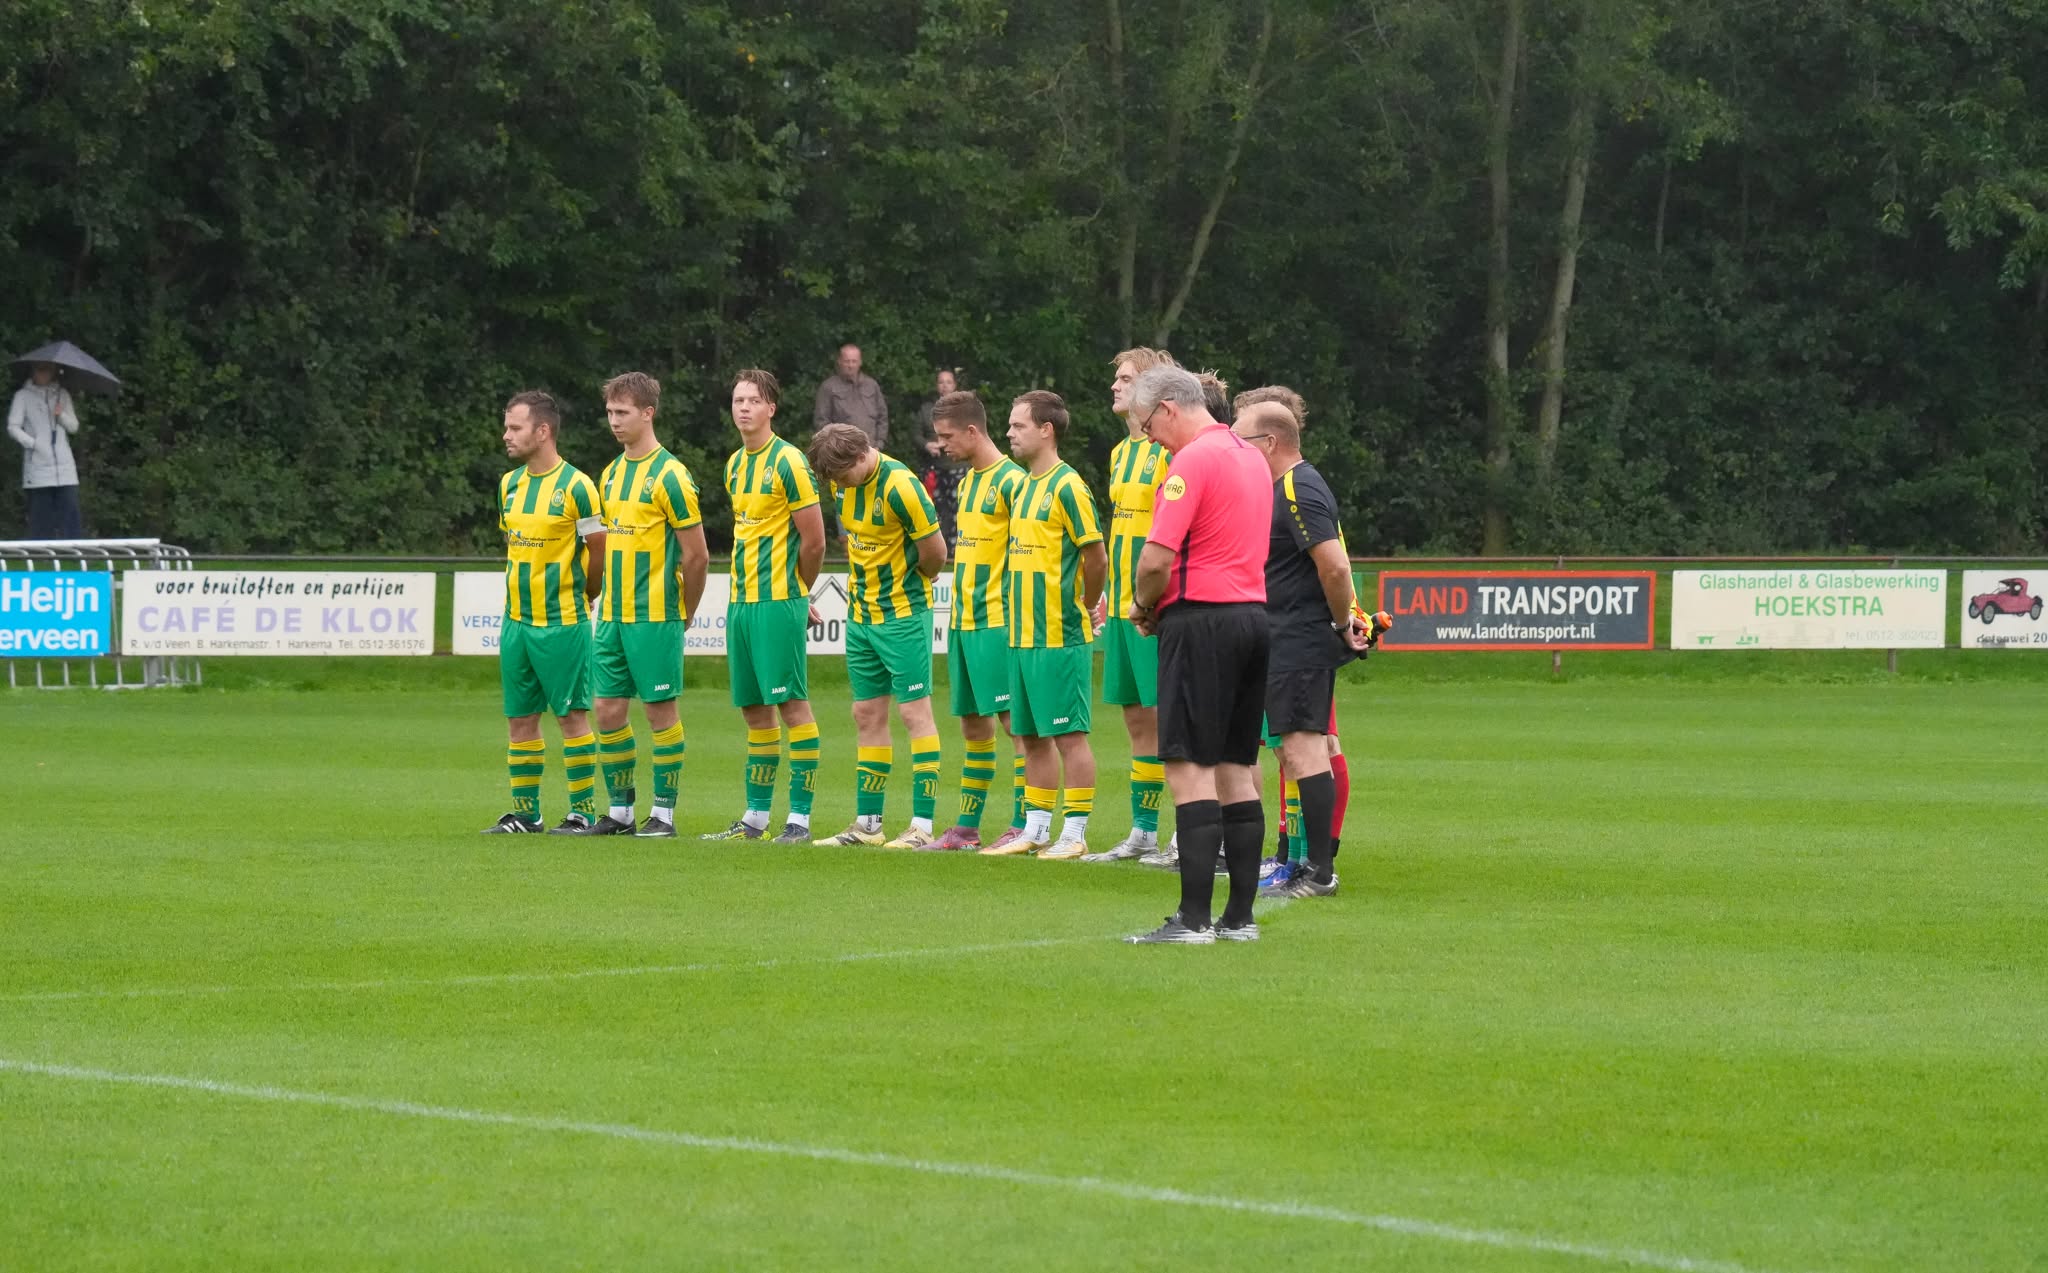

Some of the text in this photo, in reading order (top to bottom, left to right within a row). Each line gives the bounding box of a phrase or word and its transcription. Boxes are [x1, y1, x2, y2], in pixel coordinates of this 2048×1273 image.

[155, 576, 405, 599] voor bruiloften en partijen
[1699, 573, 1939, 592] Glashandel & Glasbewerking
[2, 578, 99, 620] Heijn
[1393, 585, 1639, 615] LAND TRANSPORT
[1755, 596, 1884, 617] HOEKSTRA
[138, 600, 418, 633] CAFÉ DE KLOK
[462, 615, 501, 628] VERZ
[0, 628, 98, 650] erveen
[685, 636, 725, 648] 62425
[1436, 622, 1596, 643] www.landtransport.nl
[164, 639, 191, 649] Veen
[288, 639, 333, 649] Harkema
[654, 683, 670, 691] JAKO
[771, 686, 787, 694] JAKO
[908, 682, 924, 691] JAKO
[1053, 716, 1069, 725] JAKO
